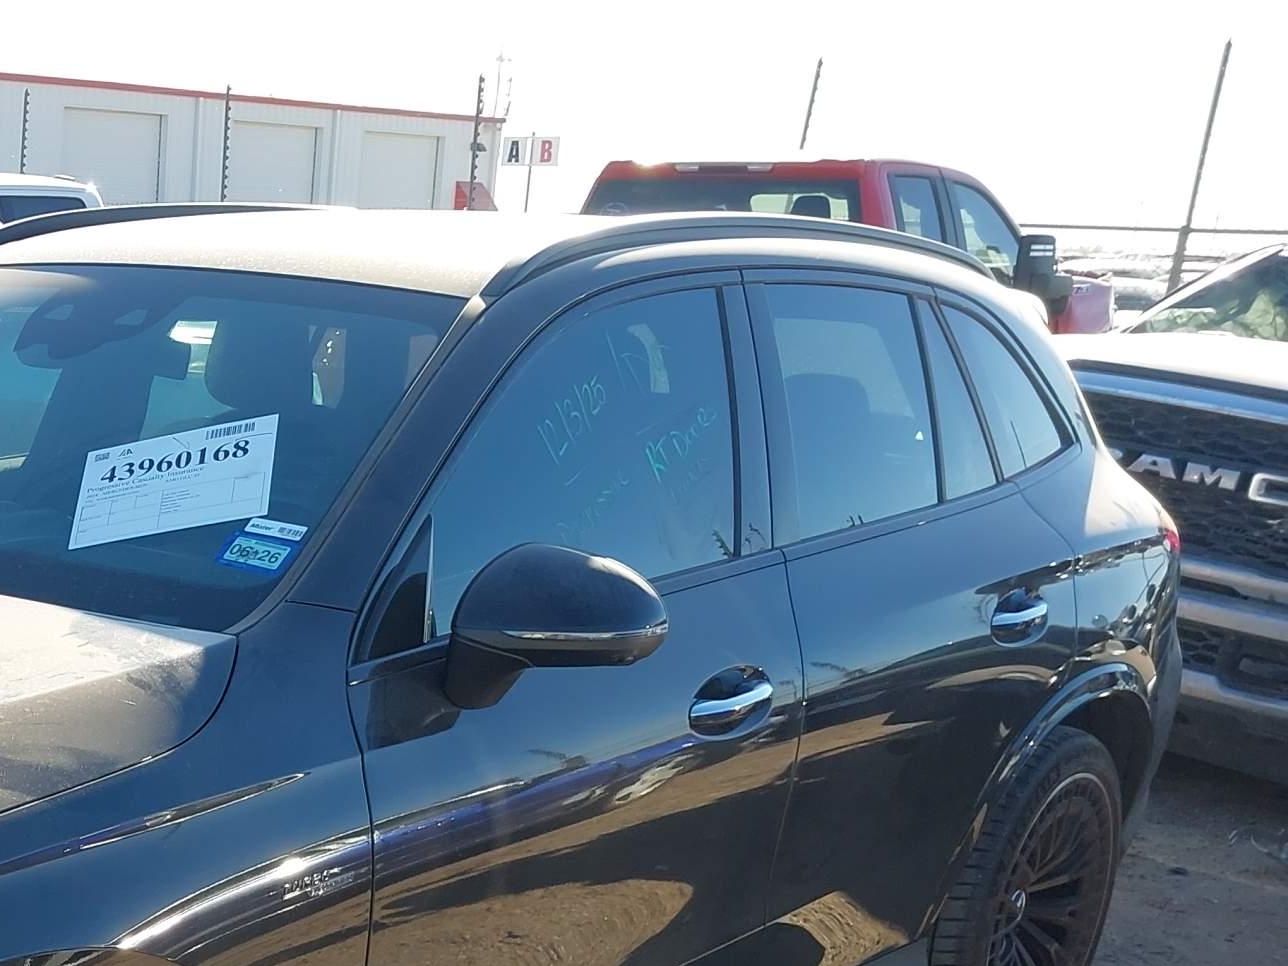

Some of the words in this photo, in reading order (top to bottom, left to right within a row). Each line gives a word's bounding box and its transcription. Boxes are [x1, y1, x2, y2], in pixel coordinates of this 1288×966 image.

[507, 140, 519, 163] A
[539, 140, 552, 163] B
[100, 439, 251, 483] 43960168
[229, 543, 253, 558] 06
[257, 550, 282, 564] 26
